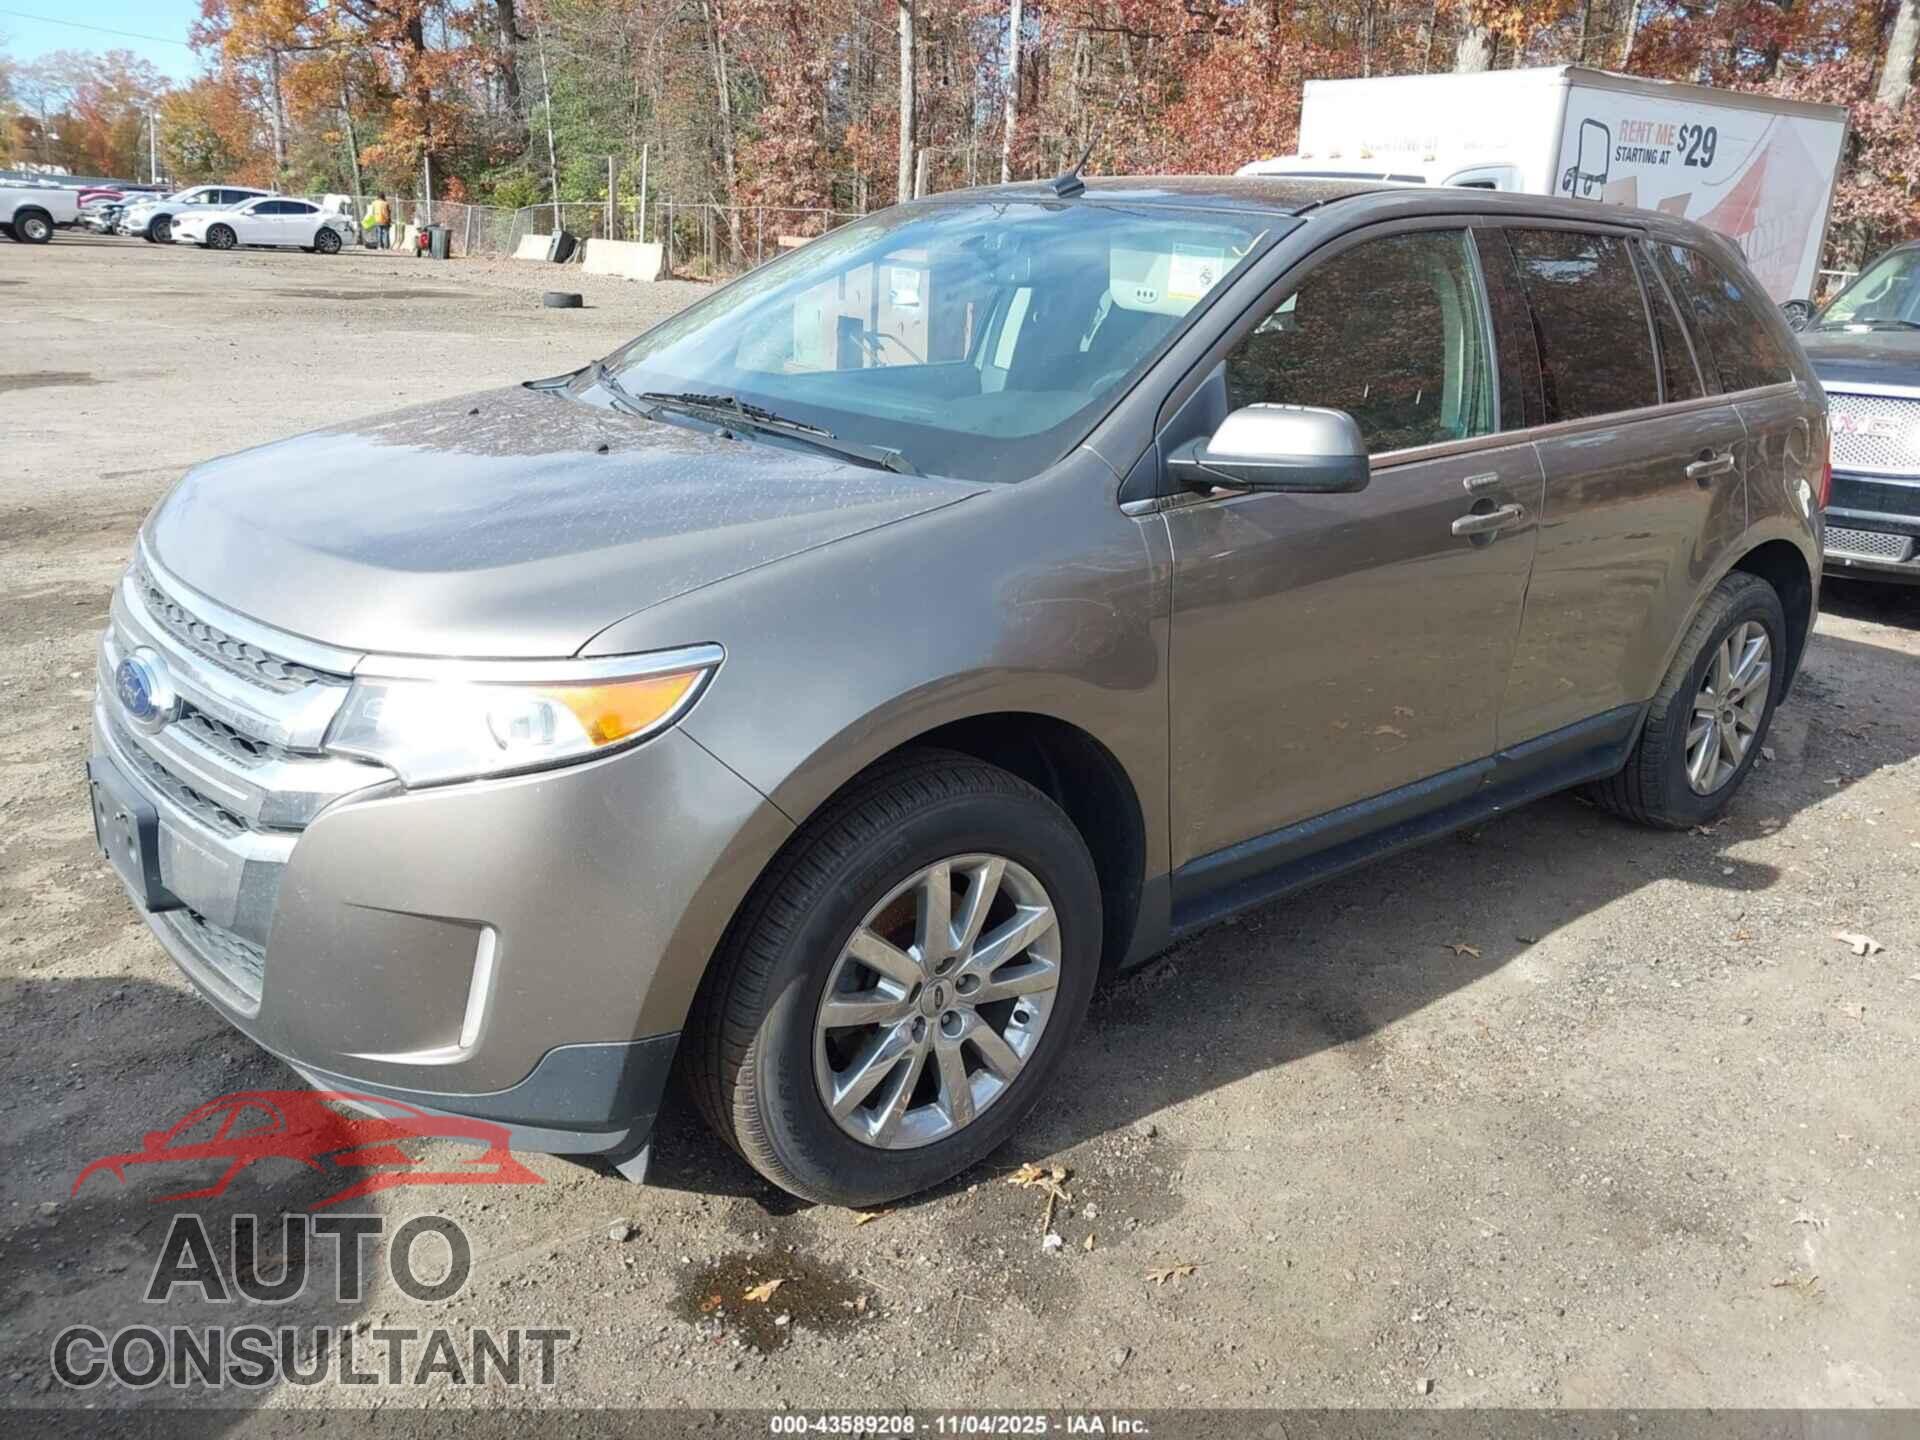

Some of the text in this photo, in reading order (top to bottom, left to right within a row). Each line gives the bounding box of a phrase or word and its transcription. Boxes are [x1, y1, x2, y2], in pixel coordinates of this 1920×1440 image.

[1619, 120, 1676, 146] RENT ME
[1676, 123, 1718, 169] $29
[1615, 145, 1671, 165] STARTING AT
